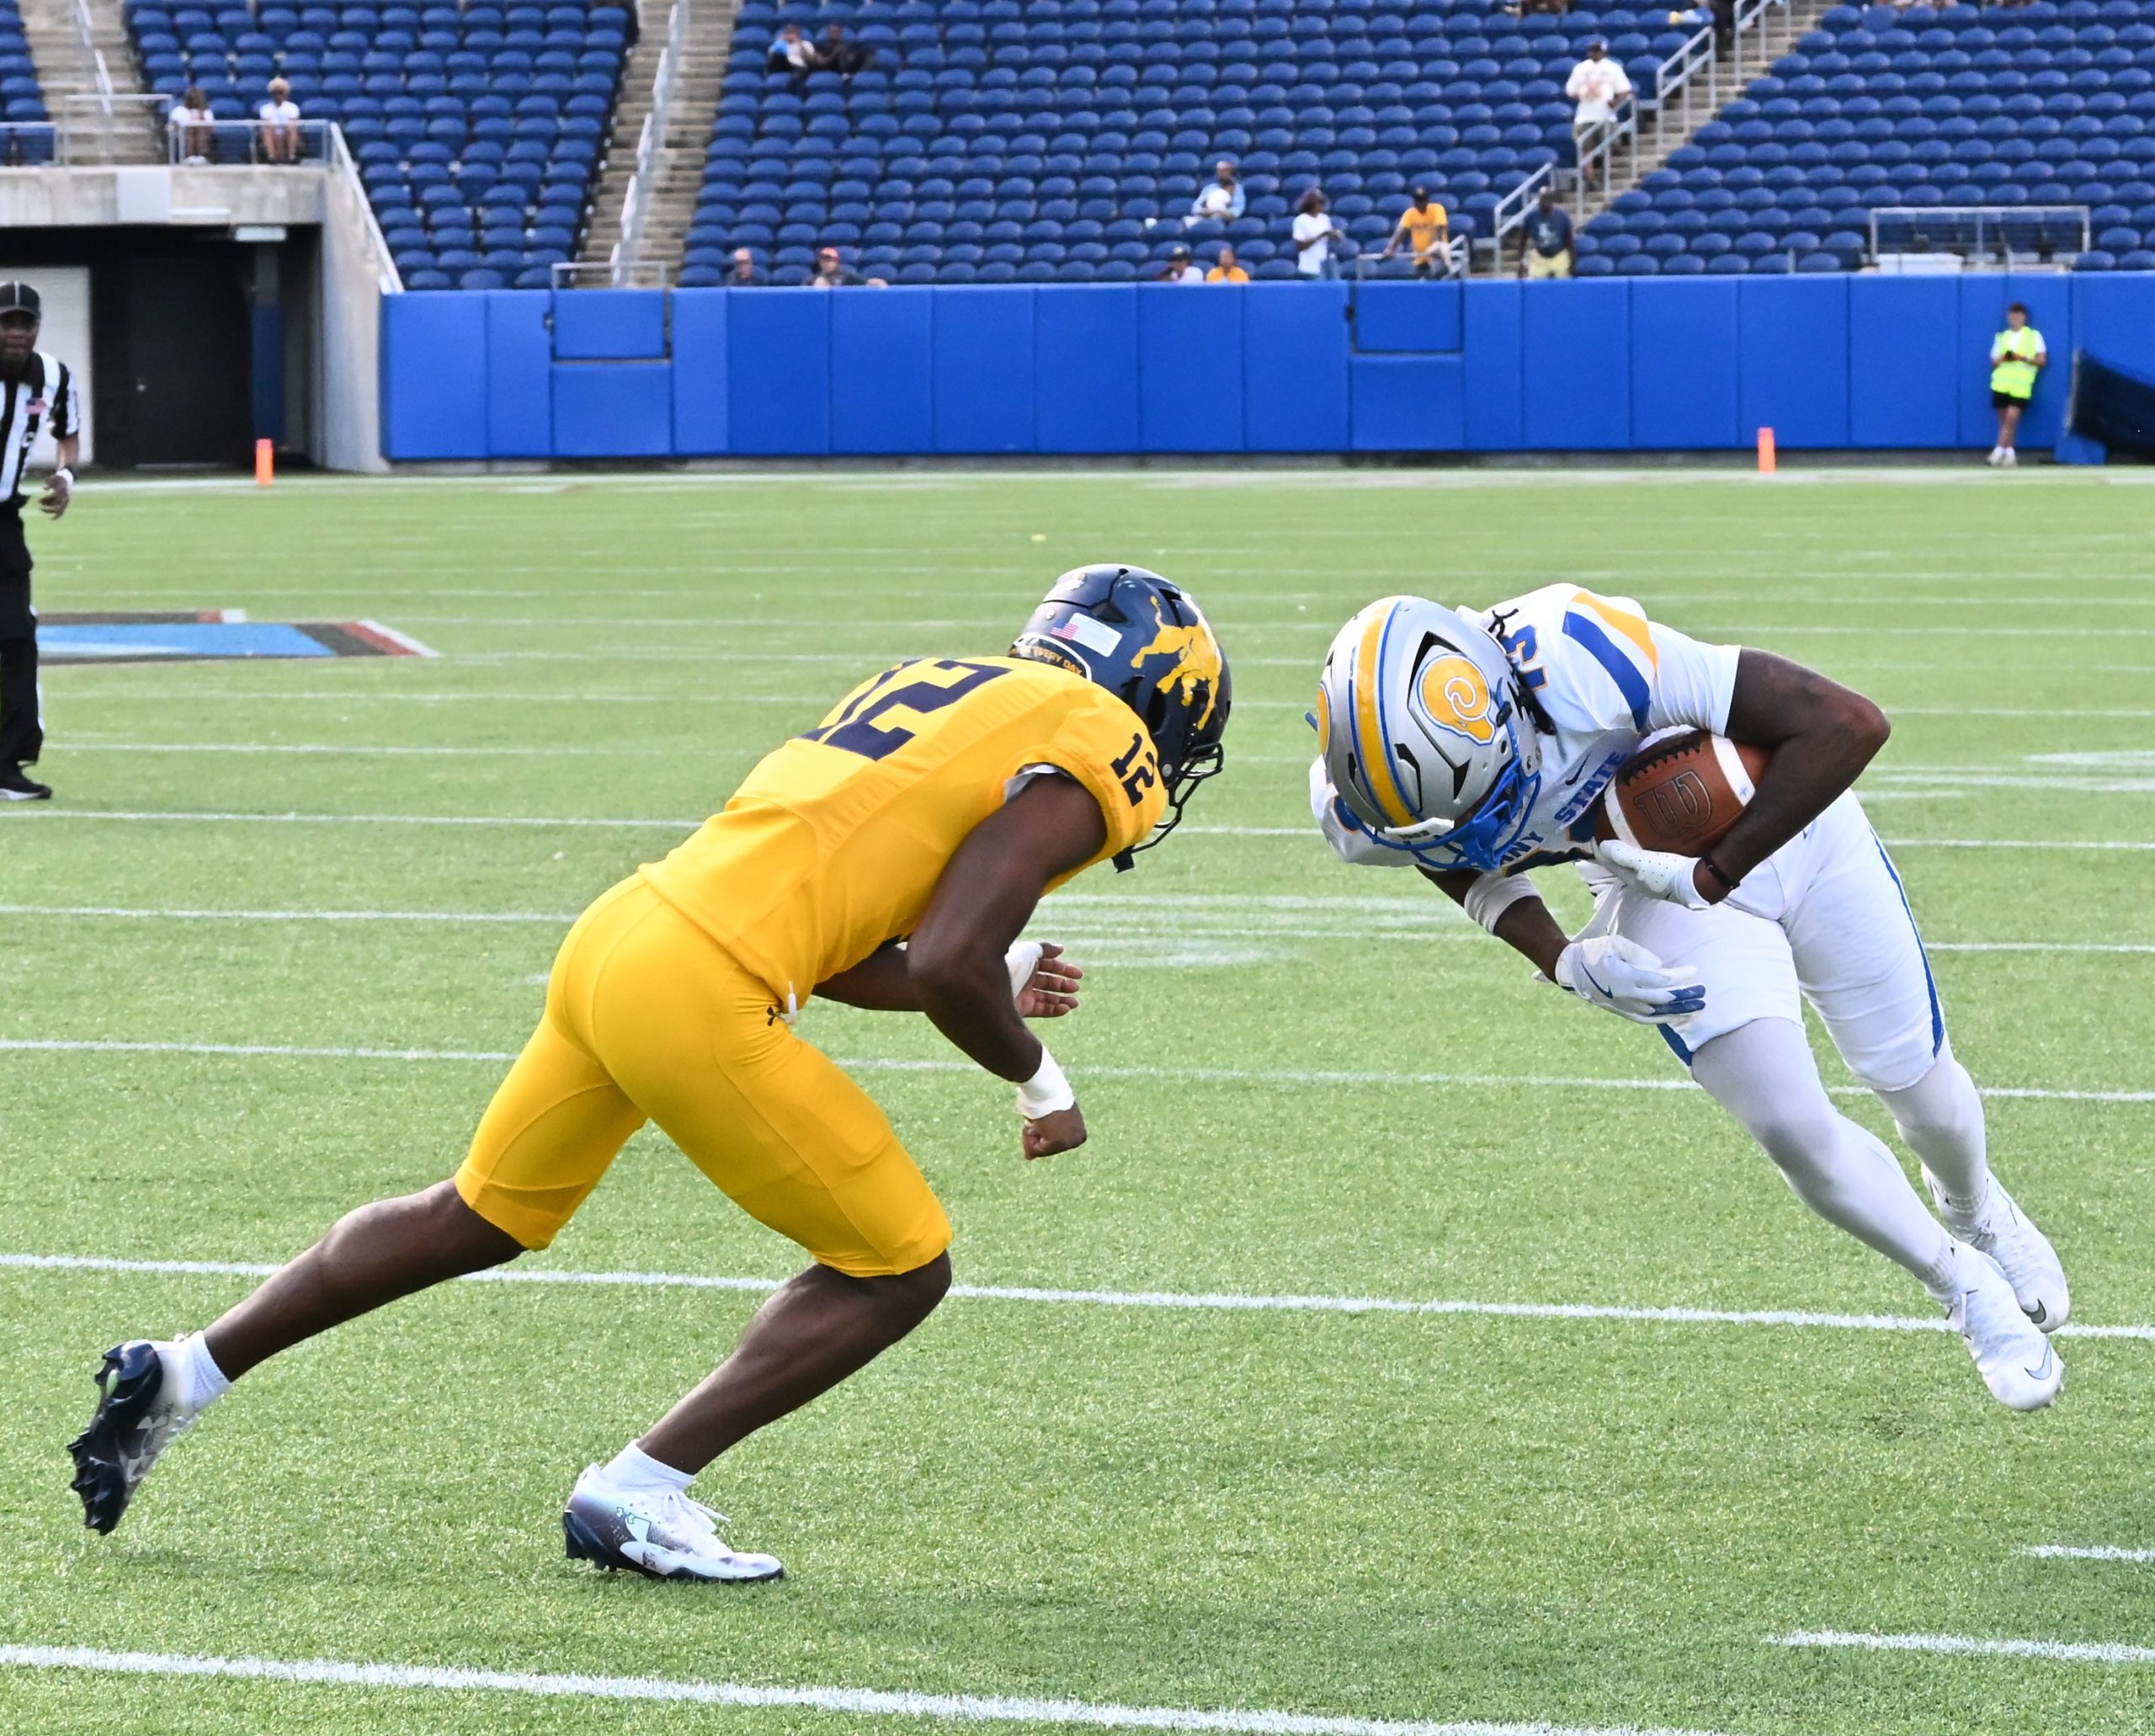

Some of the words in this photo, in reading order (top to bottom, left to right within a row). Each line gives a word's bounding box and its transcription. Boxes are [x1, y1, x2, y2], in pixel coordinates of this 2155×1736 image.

[1063, 659, 1083, 674] DAY
[797, 659, 1014, 762] 12
[1109, 732, 1155, 807] 12
[1554, 751, 1627, 823] STATE
[1499, 830, 1545, 866] ANY
